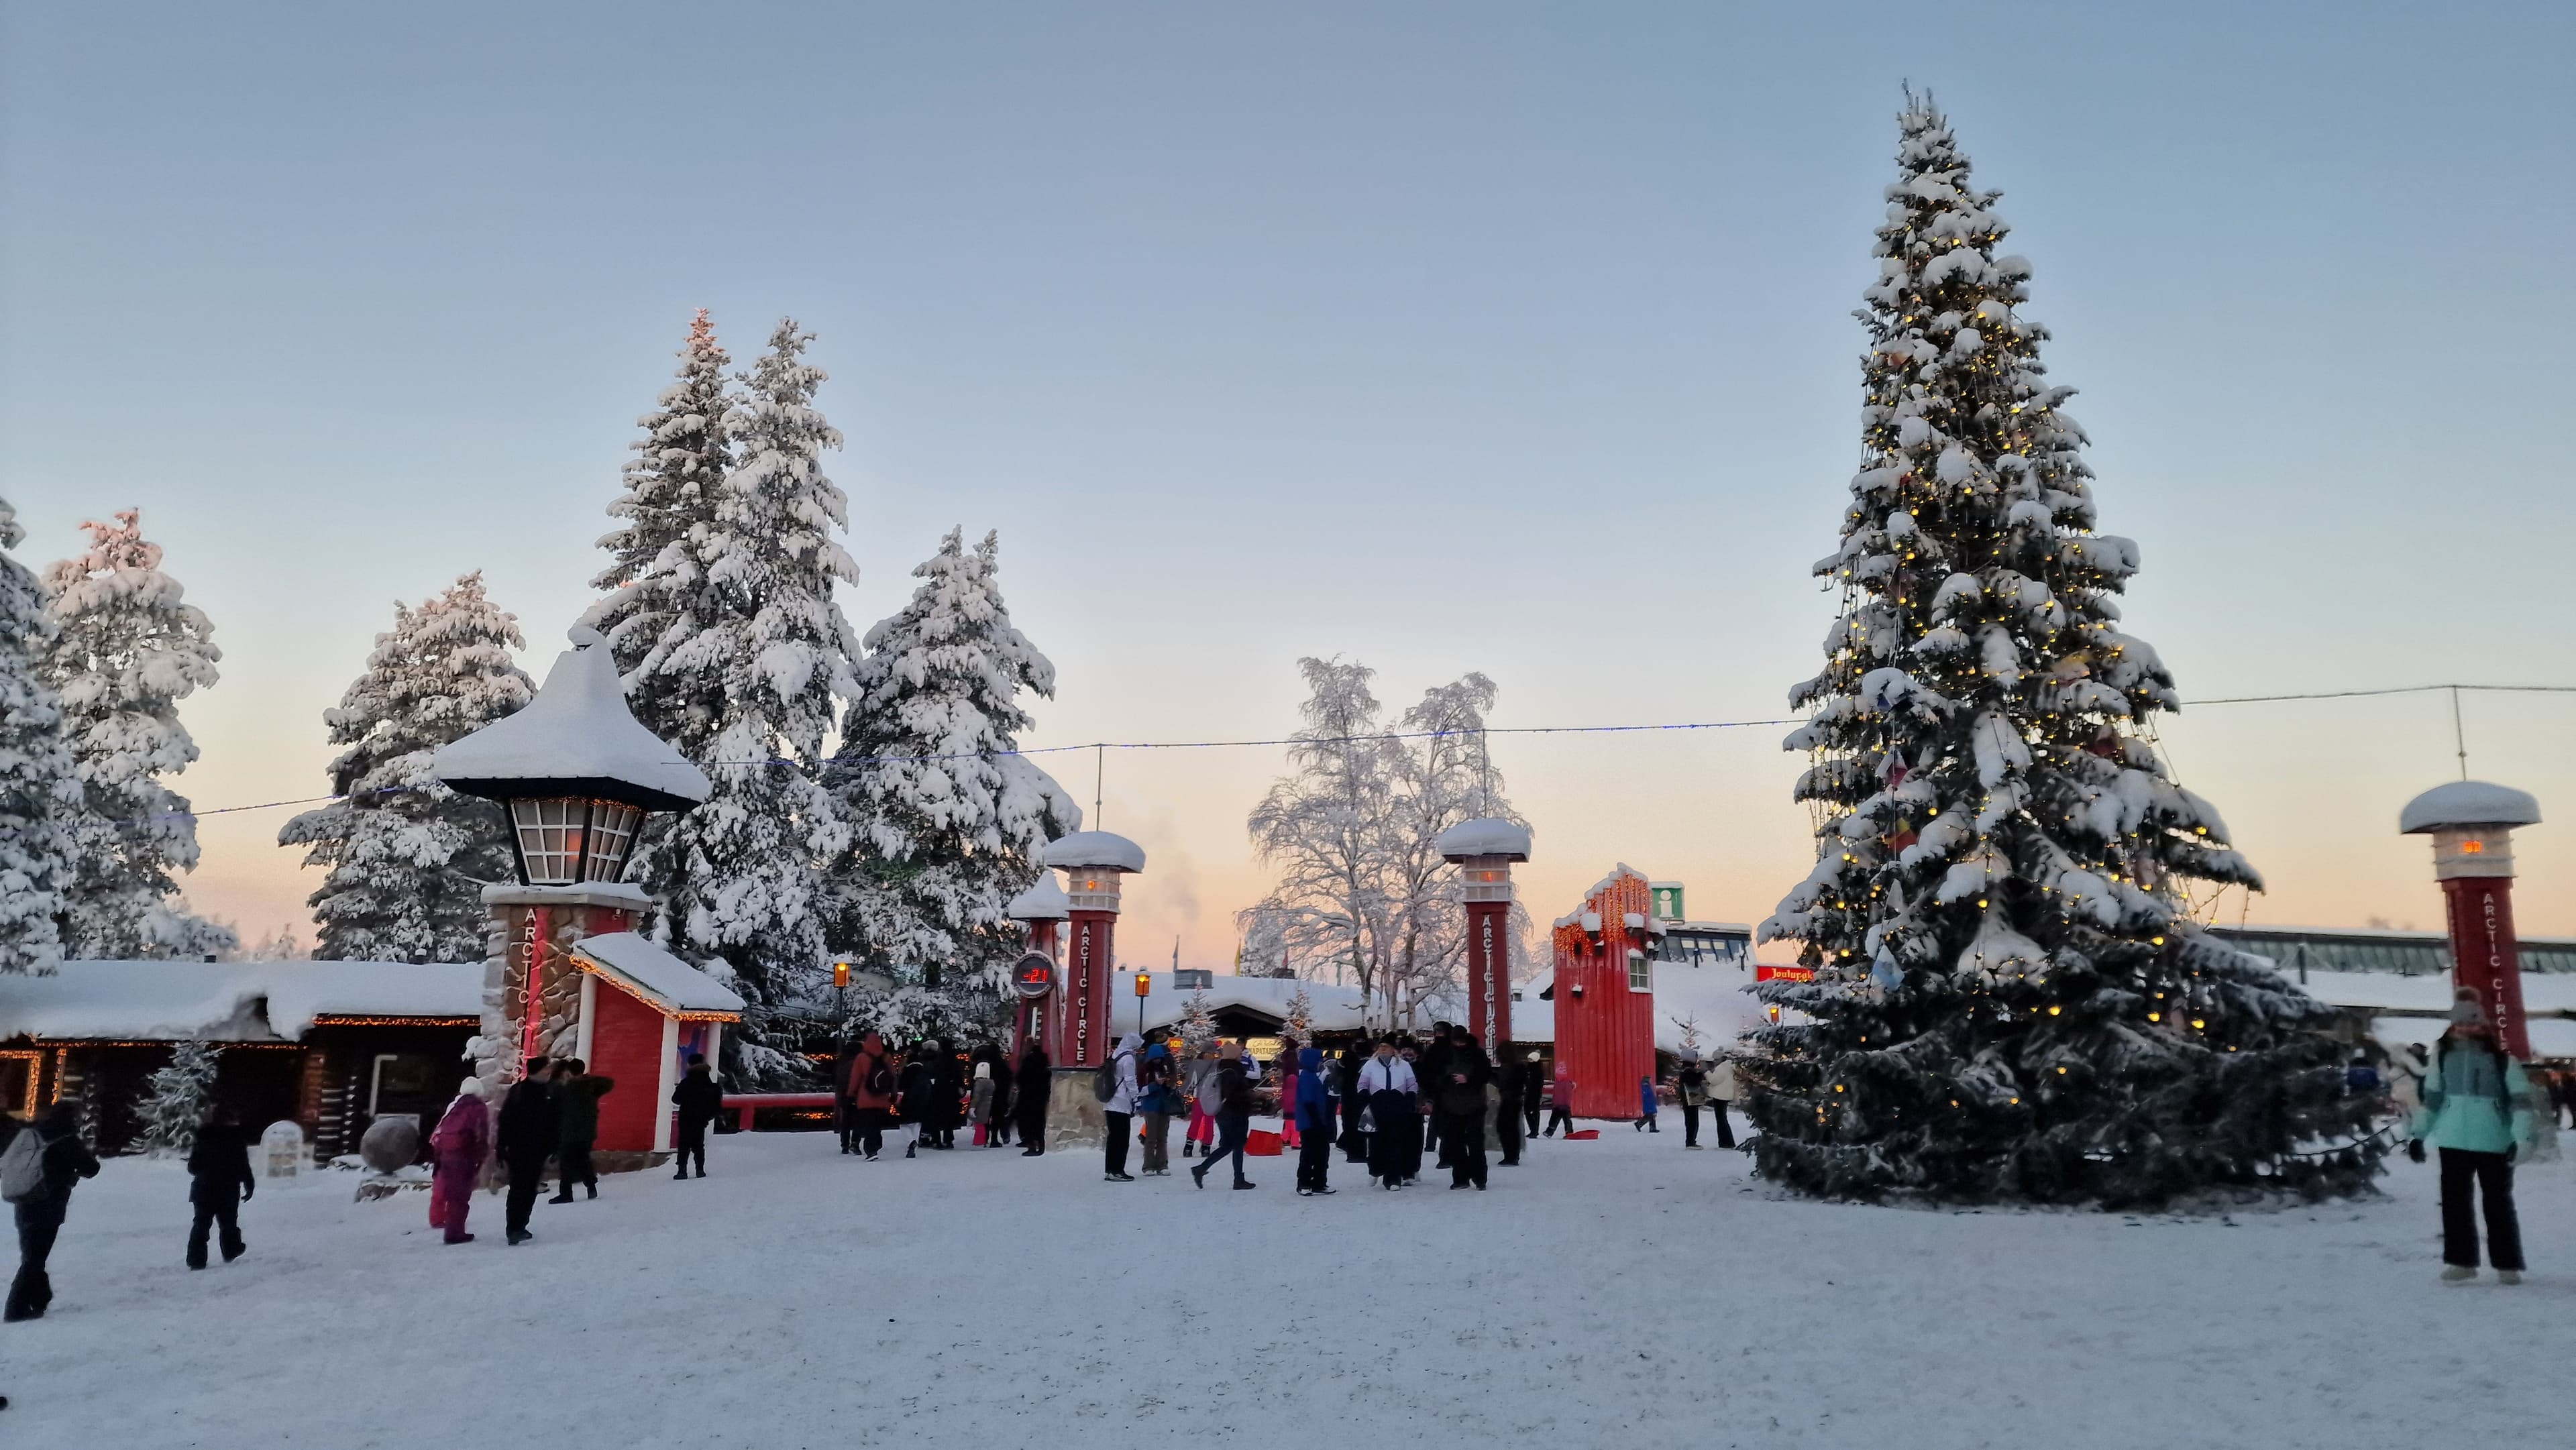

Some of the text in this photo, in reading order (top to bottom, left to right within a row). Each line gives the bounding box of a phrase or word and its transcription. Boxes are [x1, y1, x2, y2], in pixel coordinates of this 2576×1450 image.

[1483, 914, 1493, 983] ARCTIC
[2484, 893, 2501, 966] ARCTIC
[513, 908, 536, 1079] ARCTIC CIRC
[1077, 926, 1090, 1061] ARCTIC CIRCLE
